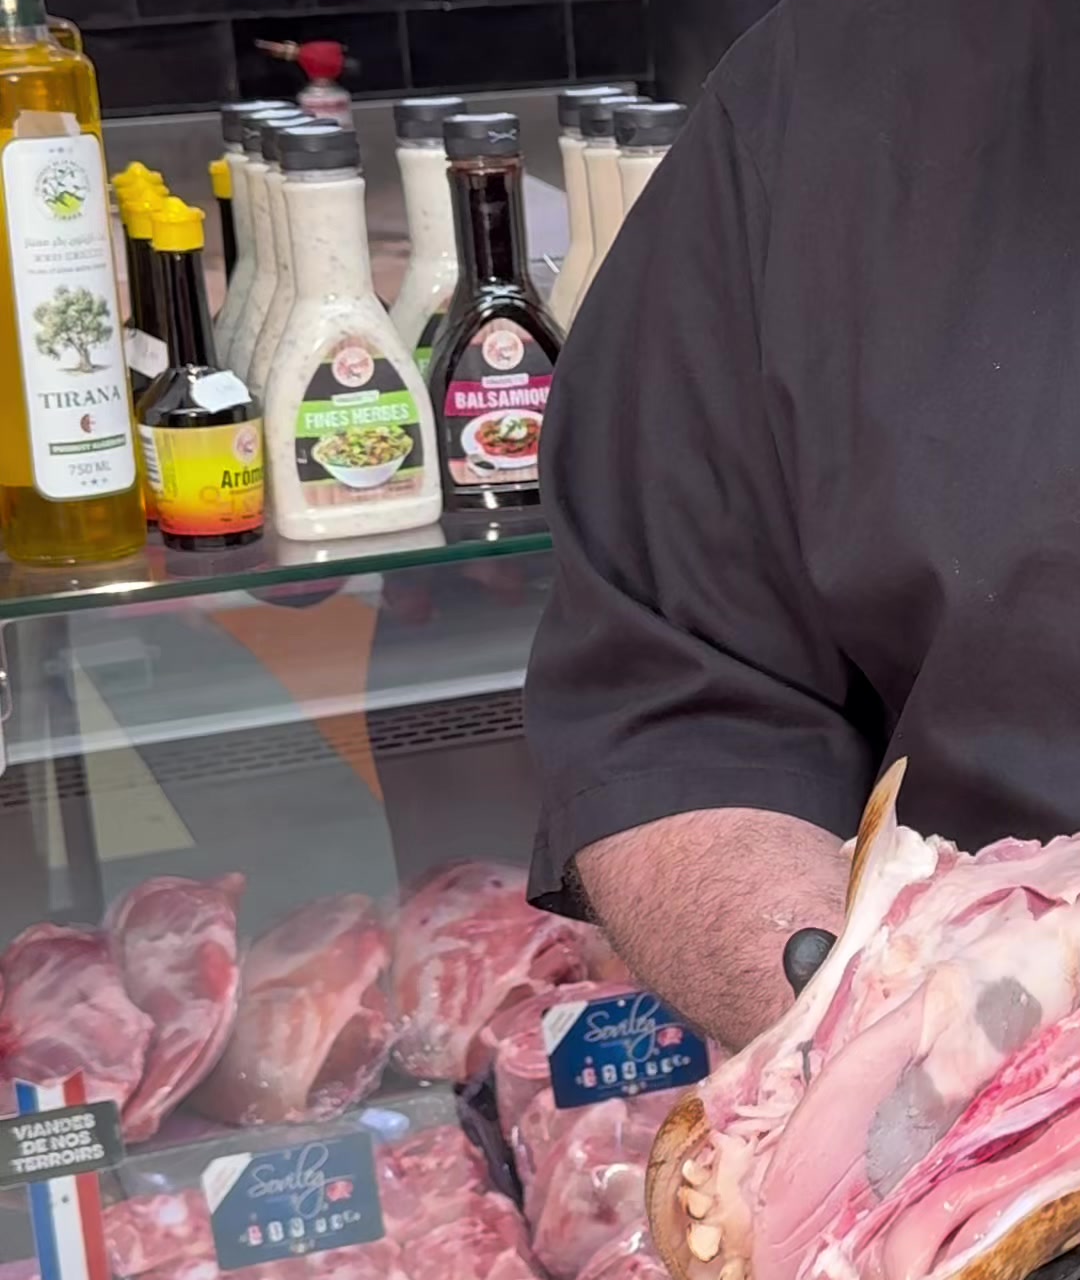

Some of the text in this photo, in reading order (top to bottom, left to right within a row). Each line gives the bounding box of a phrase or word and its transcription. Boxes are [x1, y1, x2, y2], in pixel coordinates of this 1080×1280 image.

[38, 385, 122, 409] TIRANA
[304, 403, 409, 429] FINES HERBES
[12, 1113, 96, 1140] VIANDES
[21, 1130, 92, 1155] DE NOS
[11, 1144, 105, 1172] TERROIRS
